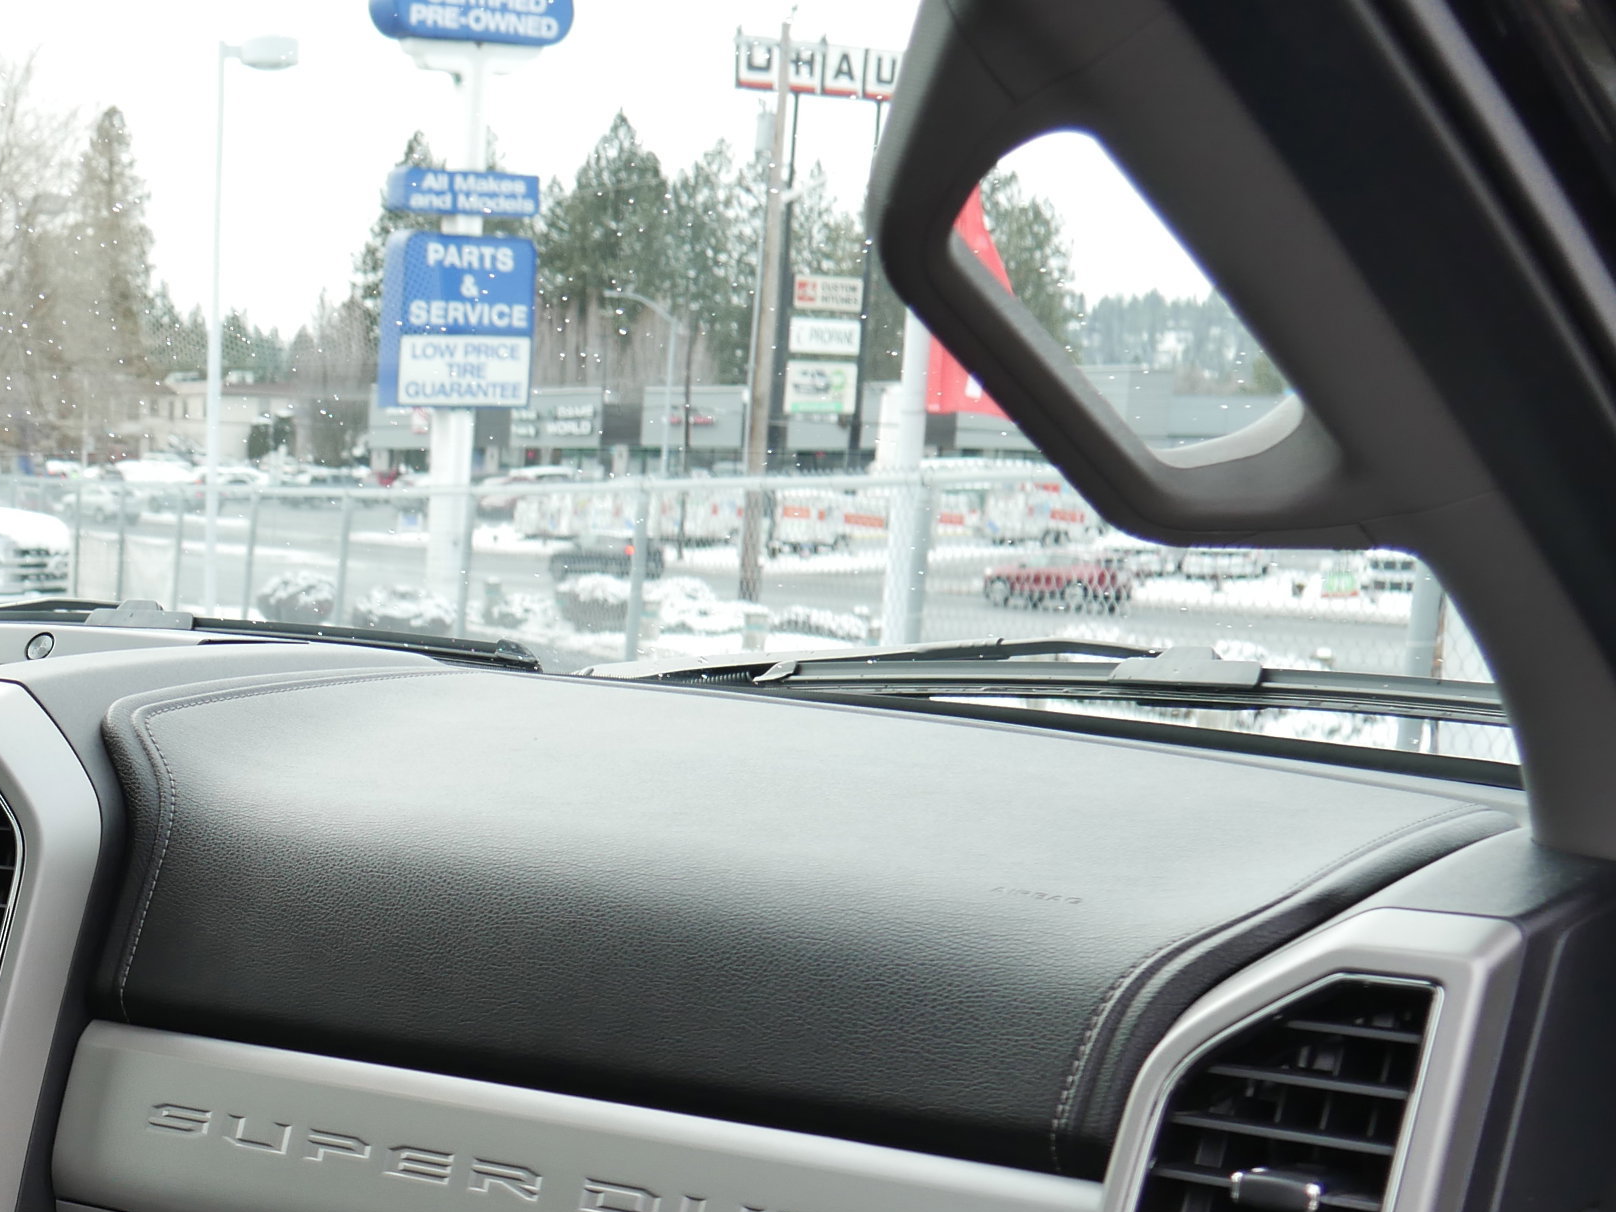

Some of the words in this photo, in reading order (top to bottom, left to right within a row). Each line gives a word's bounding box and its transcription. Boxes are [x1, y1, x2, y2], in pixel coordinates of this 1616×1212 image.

[409, 3, 559, 39] PRE-OWNED
[421, 172, 449, 191] All
[453, 173, 527, 194] Makes
[409, 192, 452, 209] and
[456, 193, 535, 213] Models
[426, 242, 515, 273] PARTS
[460, 274, 479, 298] &
[408, 300, 529, 328] SERVICE
[410, 342, 458, 360] LOW
[463, 343, 522, 361] PRICE
[445, 362, 485, 380] TIRE
[404, 381, 522, 399] GUARANTEE
[146, 1101, 544, 1202] SUPER
